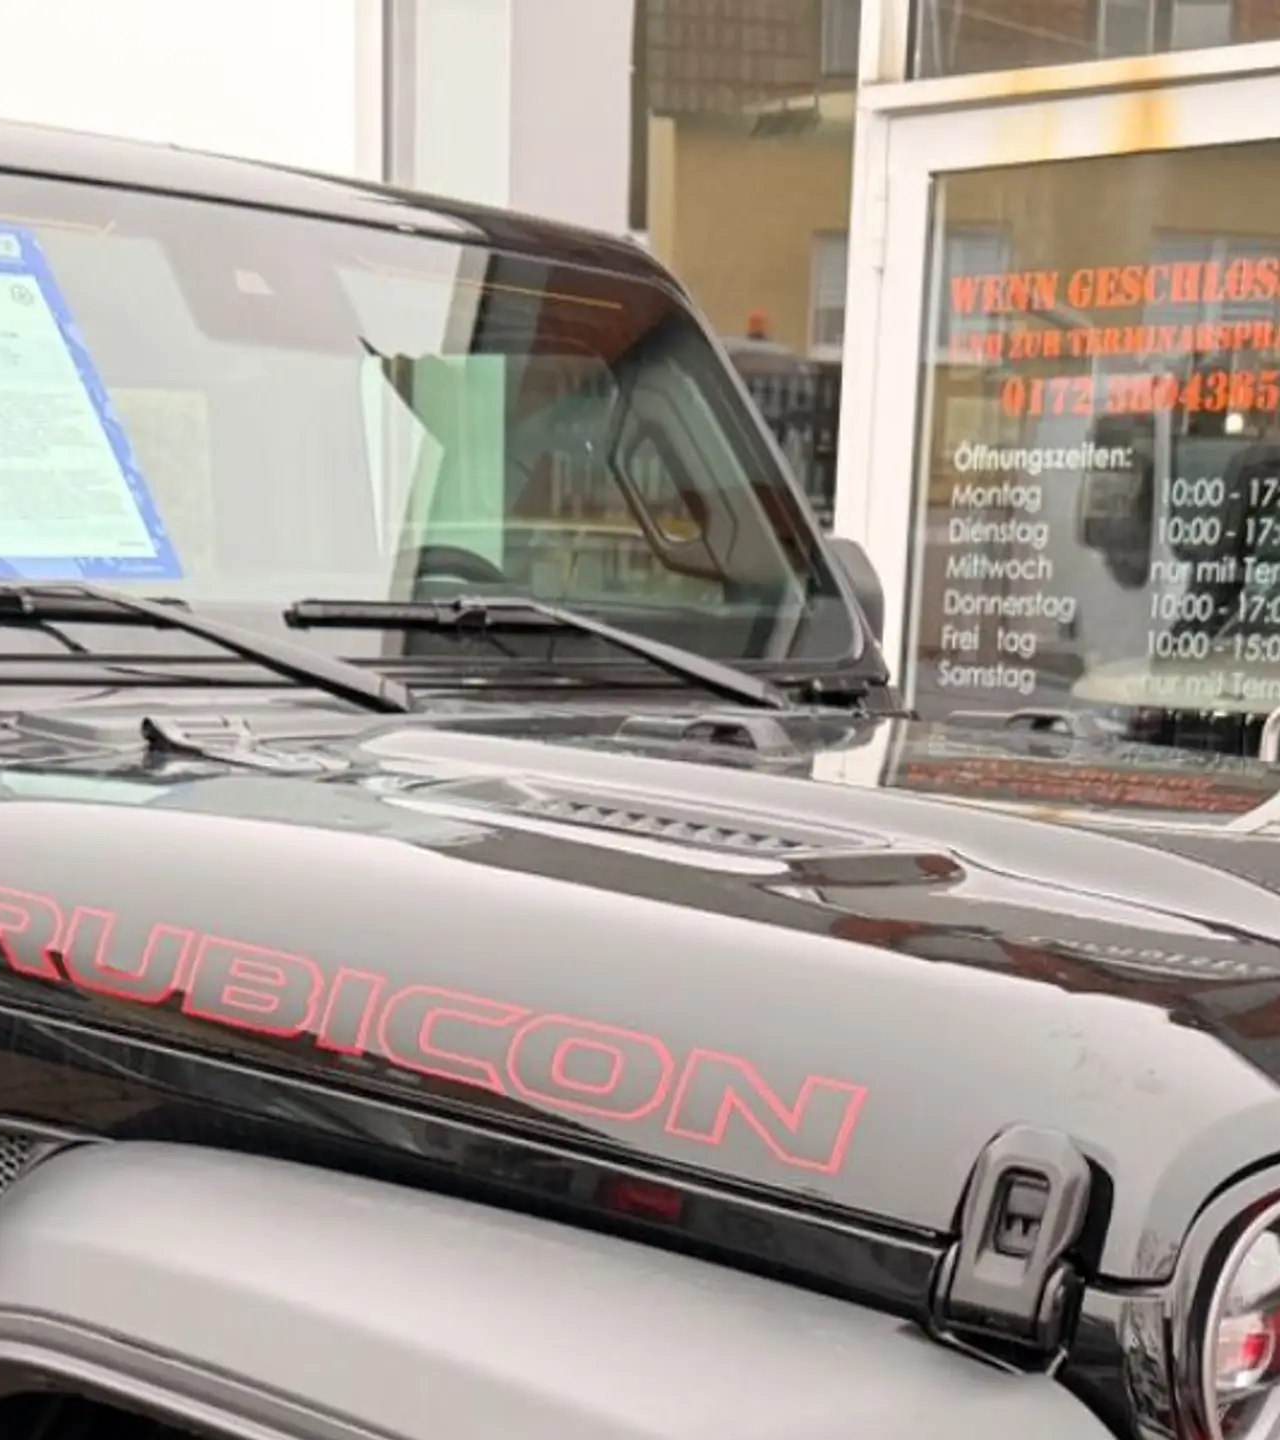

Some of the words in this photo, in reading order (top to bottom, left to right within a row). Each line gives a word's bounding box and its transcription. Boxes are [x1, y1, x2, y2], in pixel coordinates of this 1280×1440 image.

[950, 270, 1060, 314] WENN
[1009, 327, 1061, 361] ZUR
[1001, 374, 1094, 418] 0172
[953, 440, 1134, 475] Öffnungszeiten:
[951, 483, 1042, 513] Montag
[1161, 477, 1225, 508] 10:00
[949, 516, 1049, 549] Dienstag
[1157, 516, 1221, 546] 10:00
[946, 552, 1054, 581] Mittwoch
[1150, 559, 1193, 583] nur
[1197, 555, 1237, 584] mit
[943, 588, 1078, 623] Donnerstag
[1150, 591, 1214, 622] 10:00
[1148, 629, 1210, 660] 10:00
[937, 659, 1037, 696] Samstag
[1140, 675, 1182, 699] nur
[1186, 672, 1222, 700] mit
